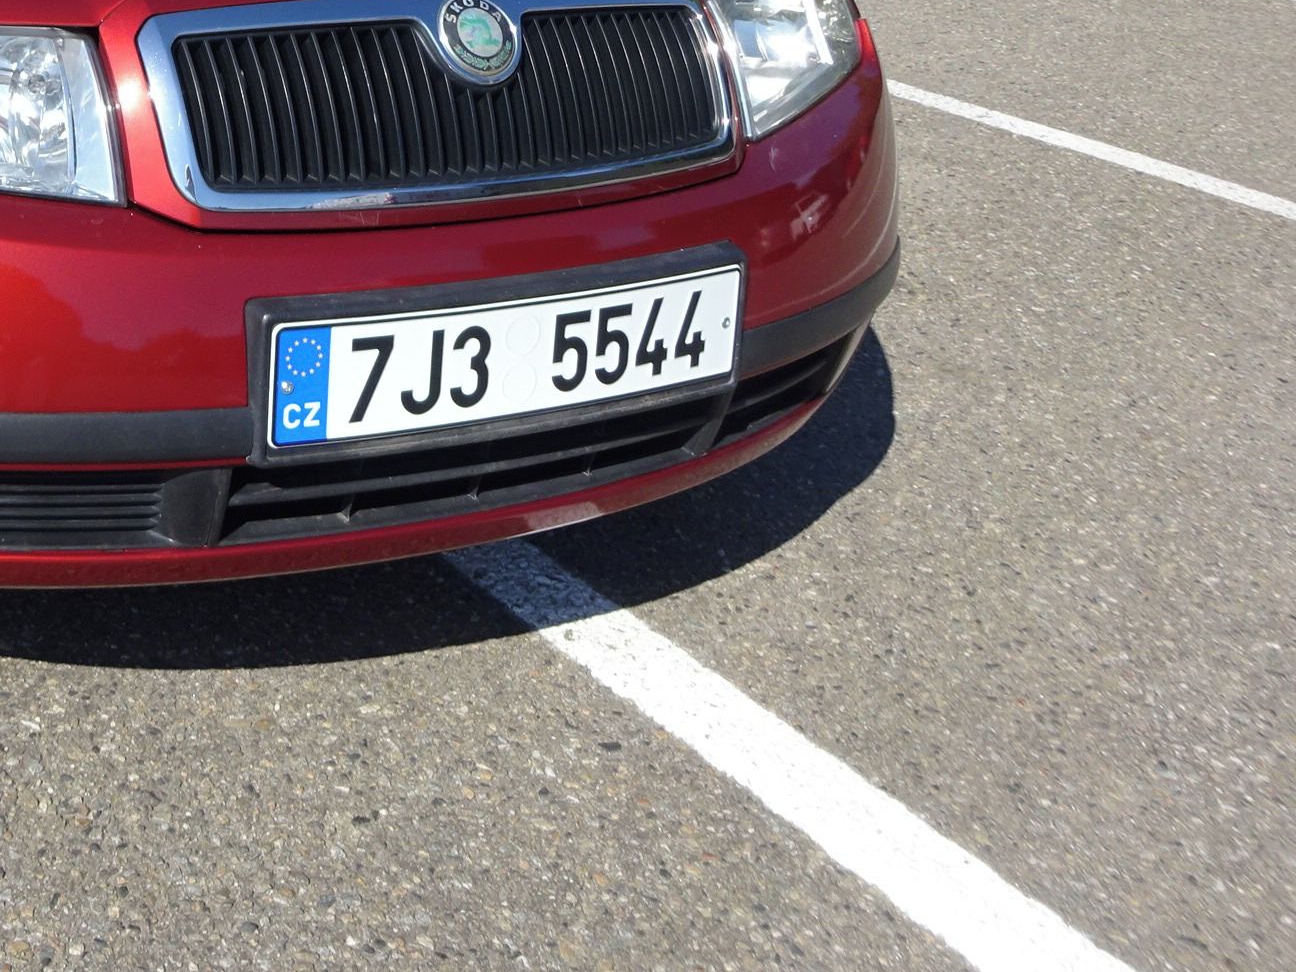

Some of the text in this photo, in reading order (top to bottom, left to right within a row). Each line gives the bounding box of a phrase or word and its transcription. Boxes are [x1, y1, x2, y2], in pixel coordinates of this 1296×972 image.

[348, 290, 706, 424] 7J3 5544
[282, 401, 321, 429] CZ
